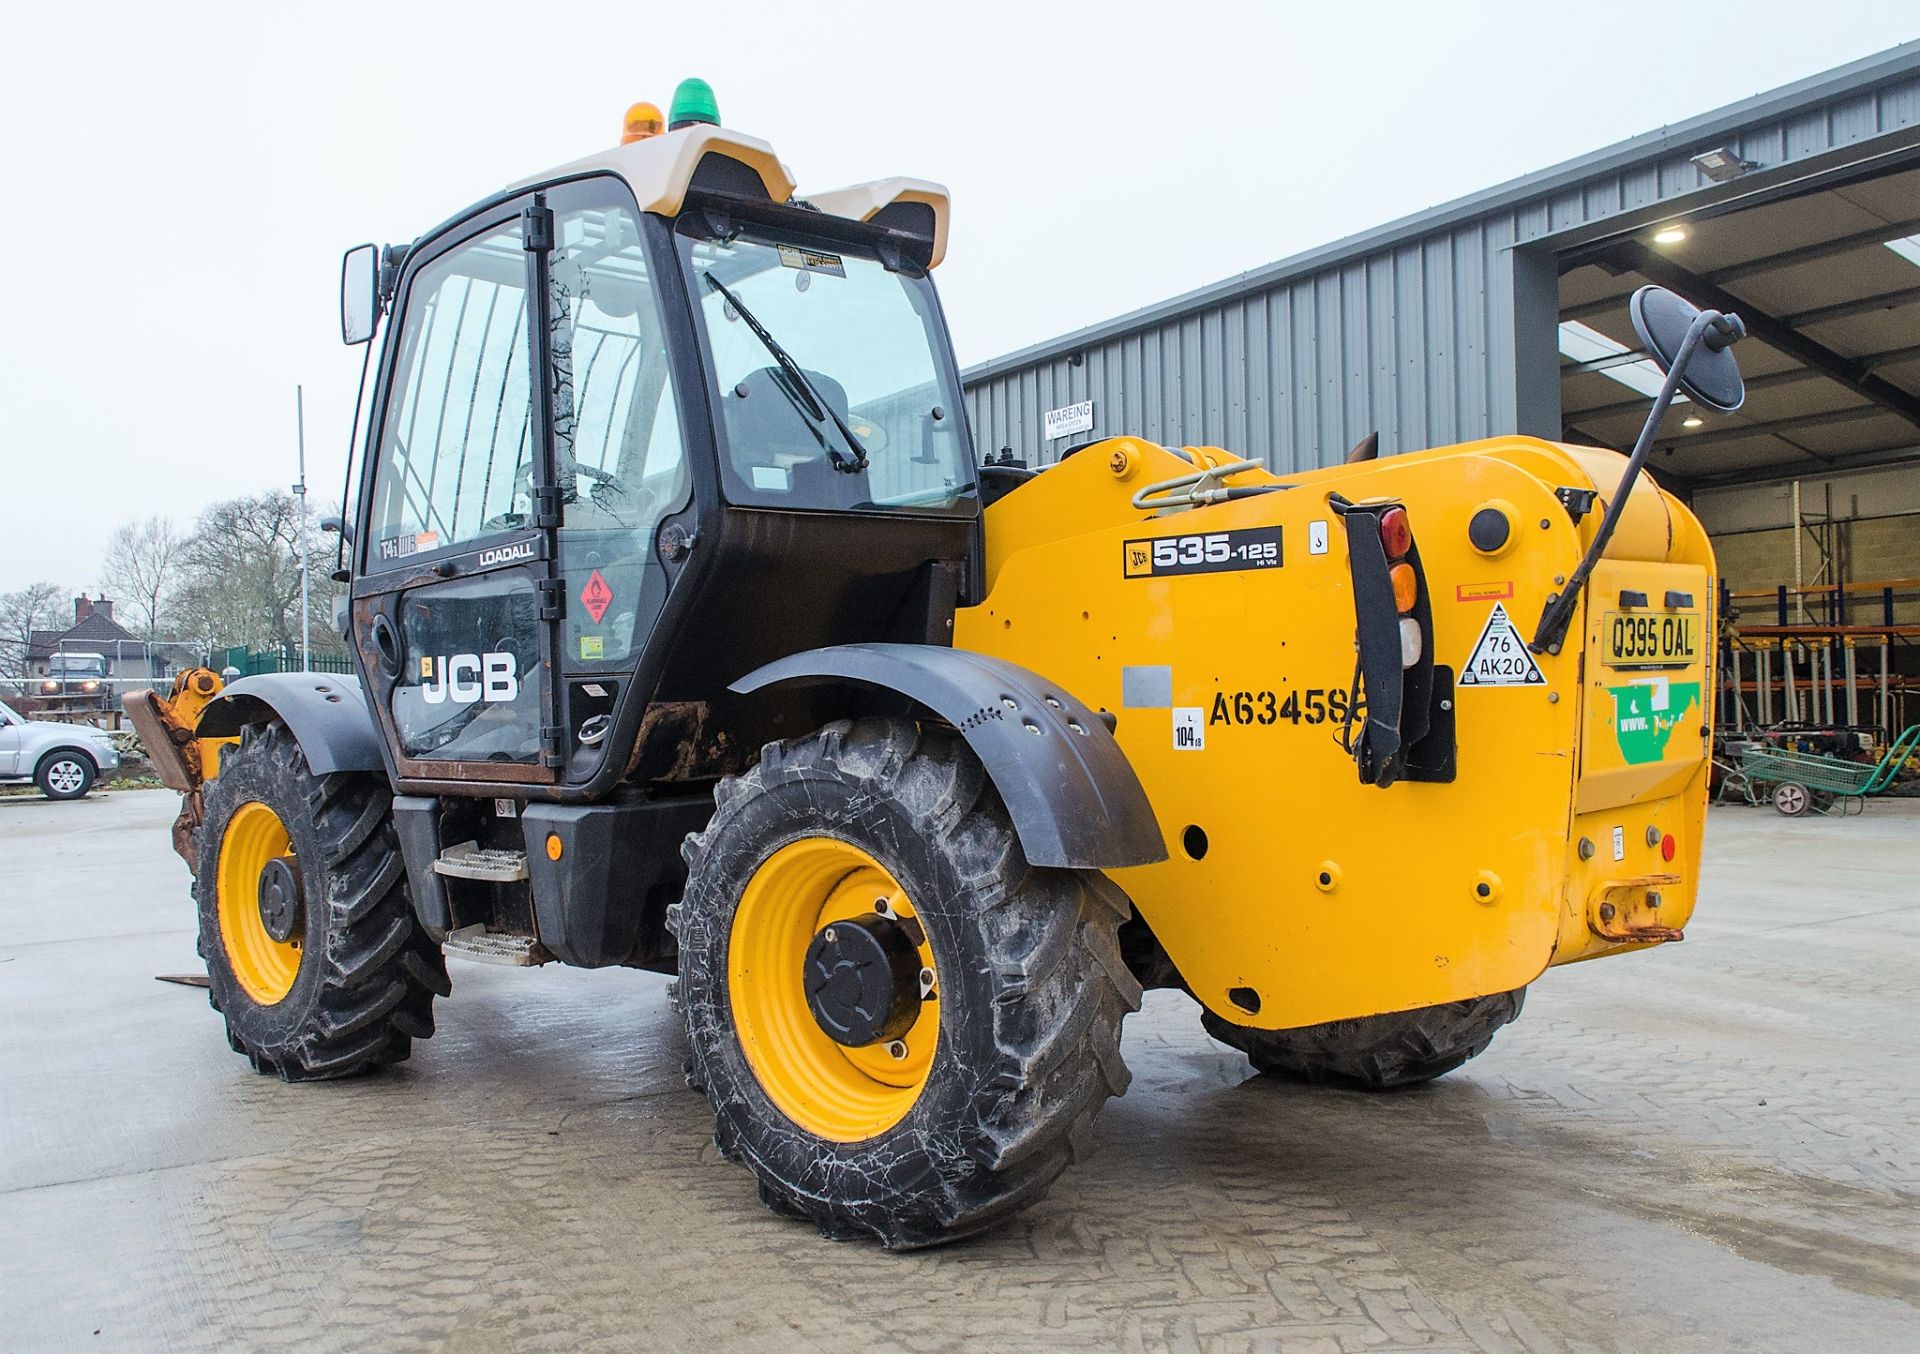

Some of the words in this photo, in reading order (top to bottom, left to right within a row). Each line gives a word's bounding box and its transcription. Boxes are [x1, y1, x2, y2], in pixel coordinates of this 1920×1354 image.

[1047, 402, 1090, 425] WAREING
[479, 543, 534, 566] LOADALL
[1489, 636, 1510, 653] 76
[1613, 617, 1657, 658] Q395
[1663, 618, 1693, 656] OAL
[1480, 657, 1524, 675] AK20
[422, 652, 518, 704] JCB
[1176, 726, 1194, 747] 104
